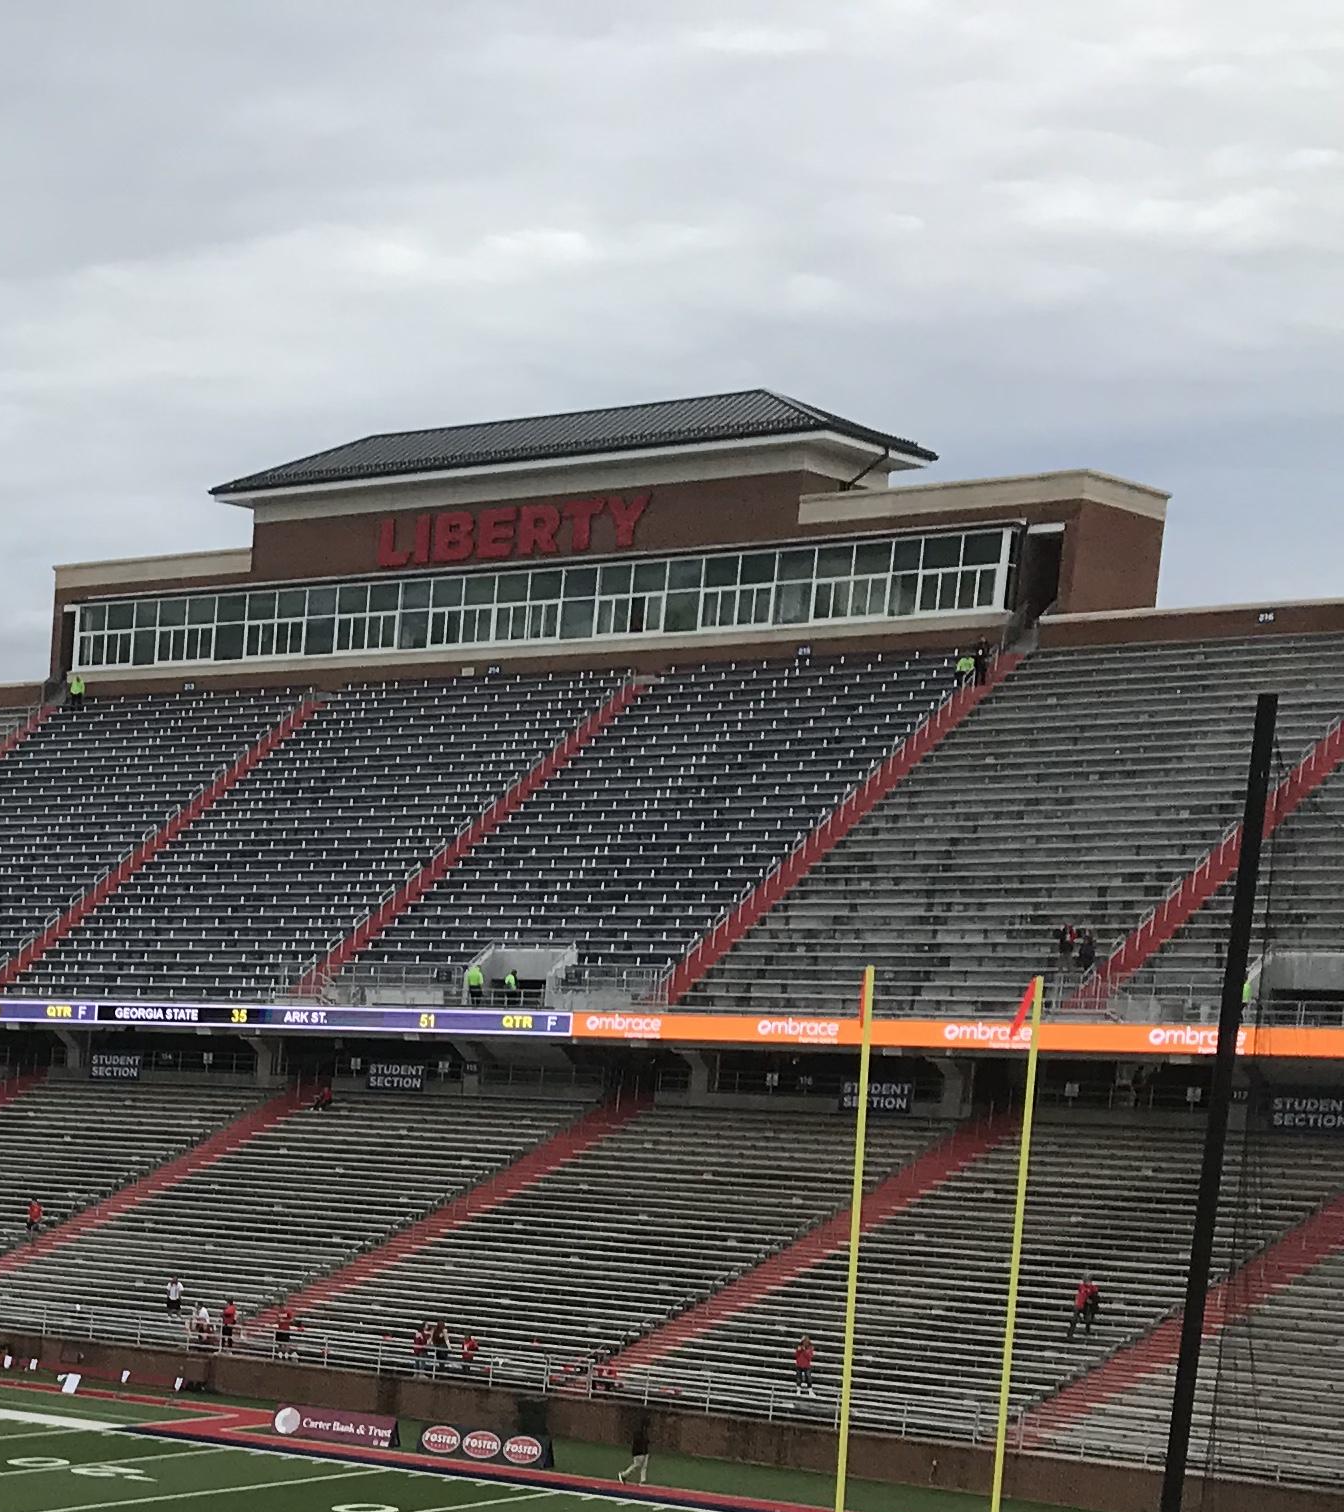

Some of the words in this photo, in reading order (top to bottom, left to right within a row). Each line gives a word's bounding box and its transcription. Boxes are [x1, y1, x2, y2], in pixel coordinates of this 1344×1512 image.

[377, 491, 652, 567] LIBERTY
[46, 1005, 72, 1018] QTR
[78, 1006, 86, 1020] F
[114, 1008, 165, 1021] GEORGIA
[166, 1008, 198, 1022] STATE
[231, 1009, 248, 1023] 35
[284, 1010, 309, 1023] ARK
[310, 1011, 328, 1024] ST.
[419, 1014, 436, 1029] 51
[502, 1015, 533, 1029] QTR
[547, 1017, 557, 1031] F
[586, 1013, 661, 1031] embrace
[758, 1017, 839, 1036] embrace
[1149, 1025, 1248, 1045] embrae
[92, 1054, 140, 1066] STUDENT
[92, 1066, 138, 1077] SECTION
[369, 1064, 425, 1076] STUDENT
[369, 1076, 422, 1088] SECTION
[843, 1082, 912, 1095] STDENT
[1273, 1097, 1343, 1112] STUDEN
[302, 1417, 331, 1430] Carter
[332, 1421, 354, 1434] Bank
[356, 1424, 366, 1435] &
[368, 1425, 392, 1438] Trust
[424, 1430, 457, 1445] FOSTER
[465, 1436, 498, 1450] FOSTER
[505, 1442, 538, 1455] FOSTER
